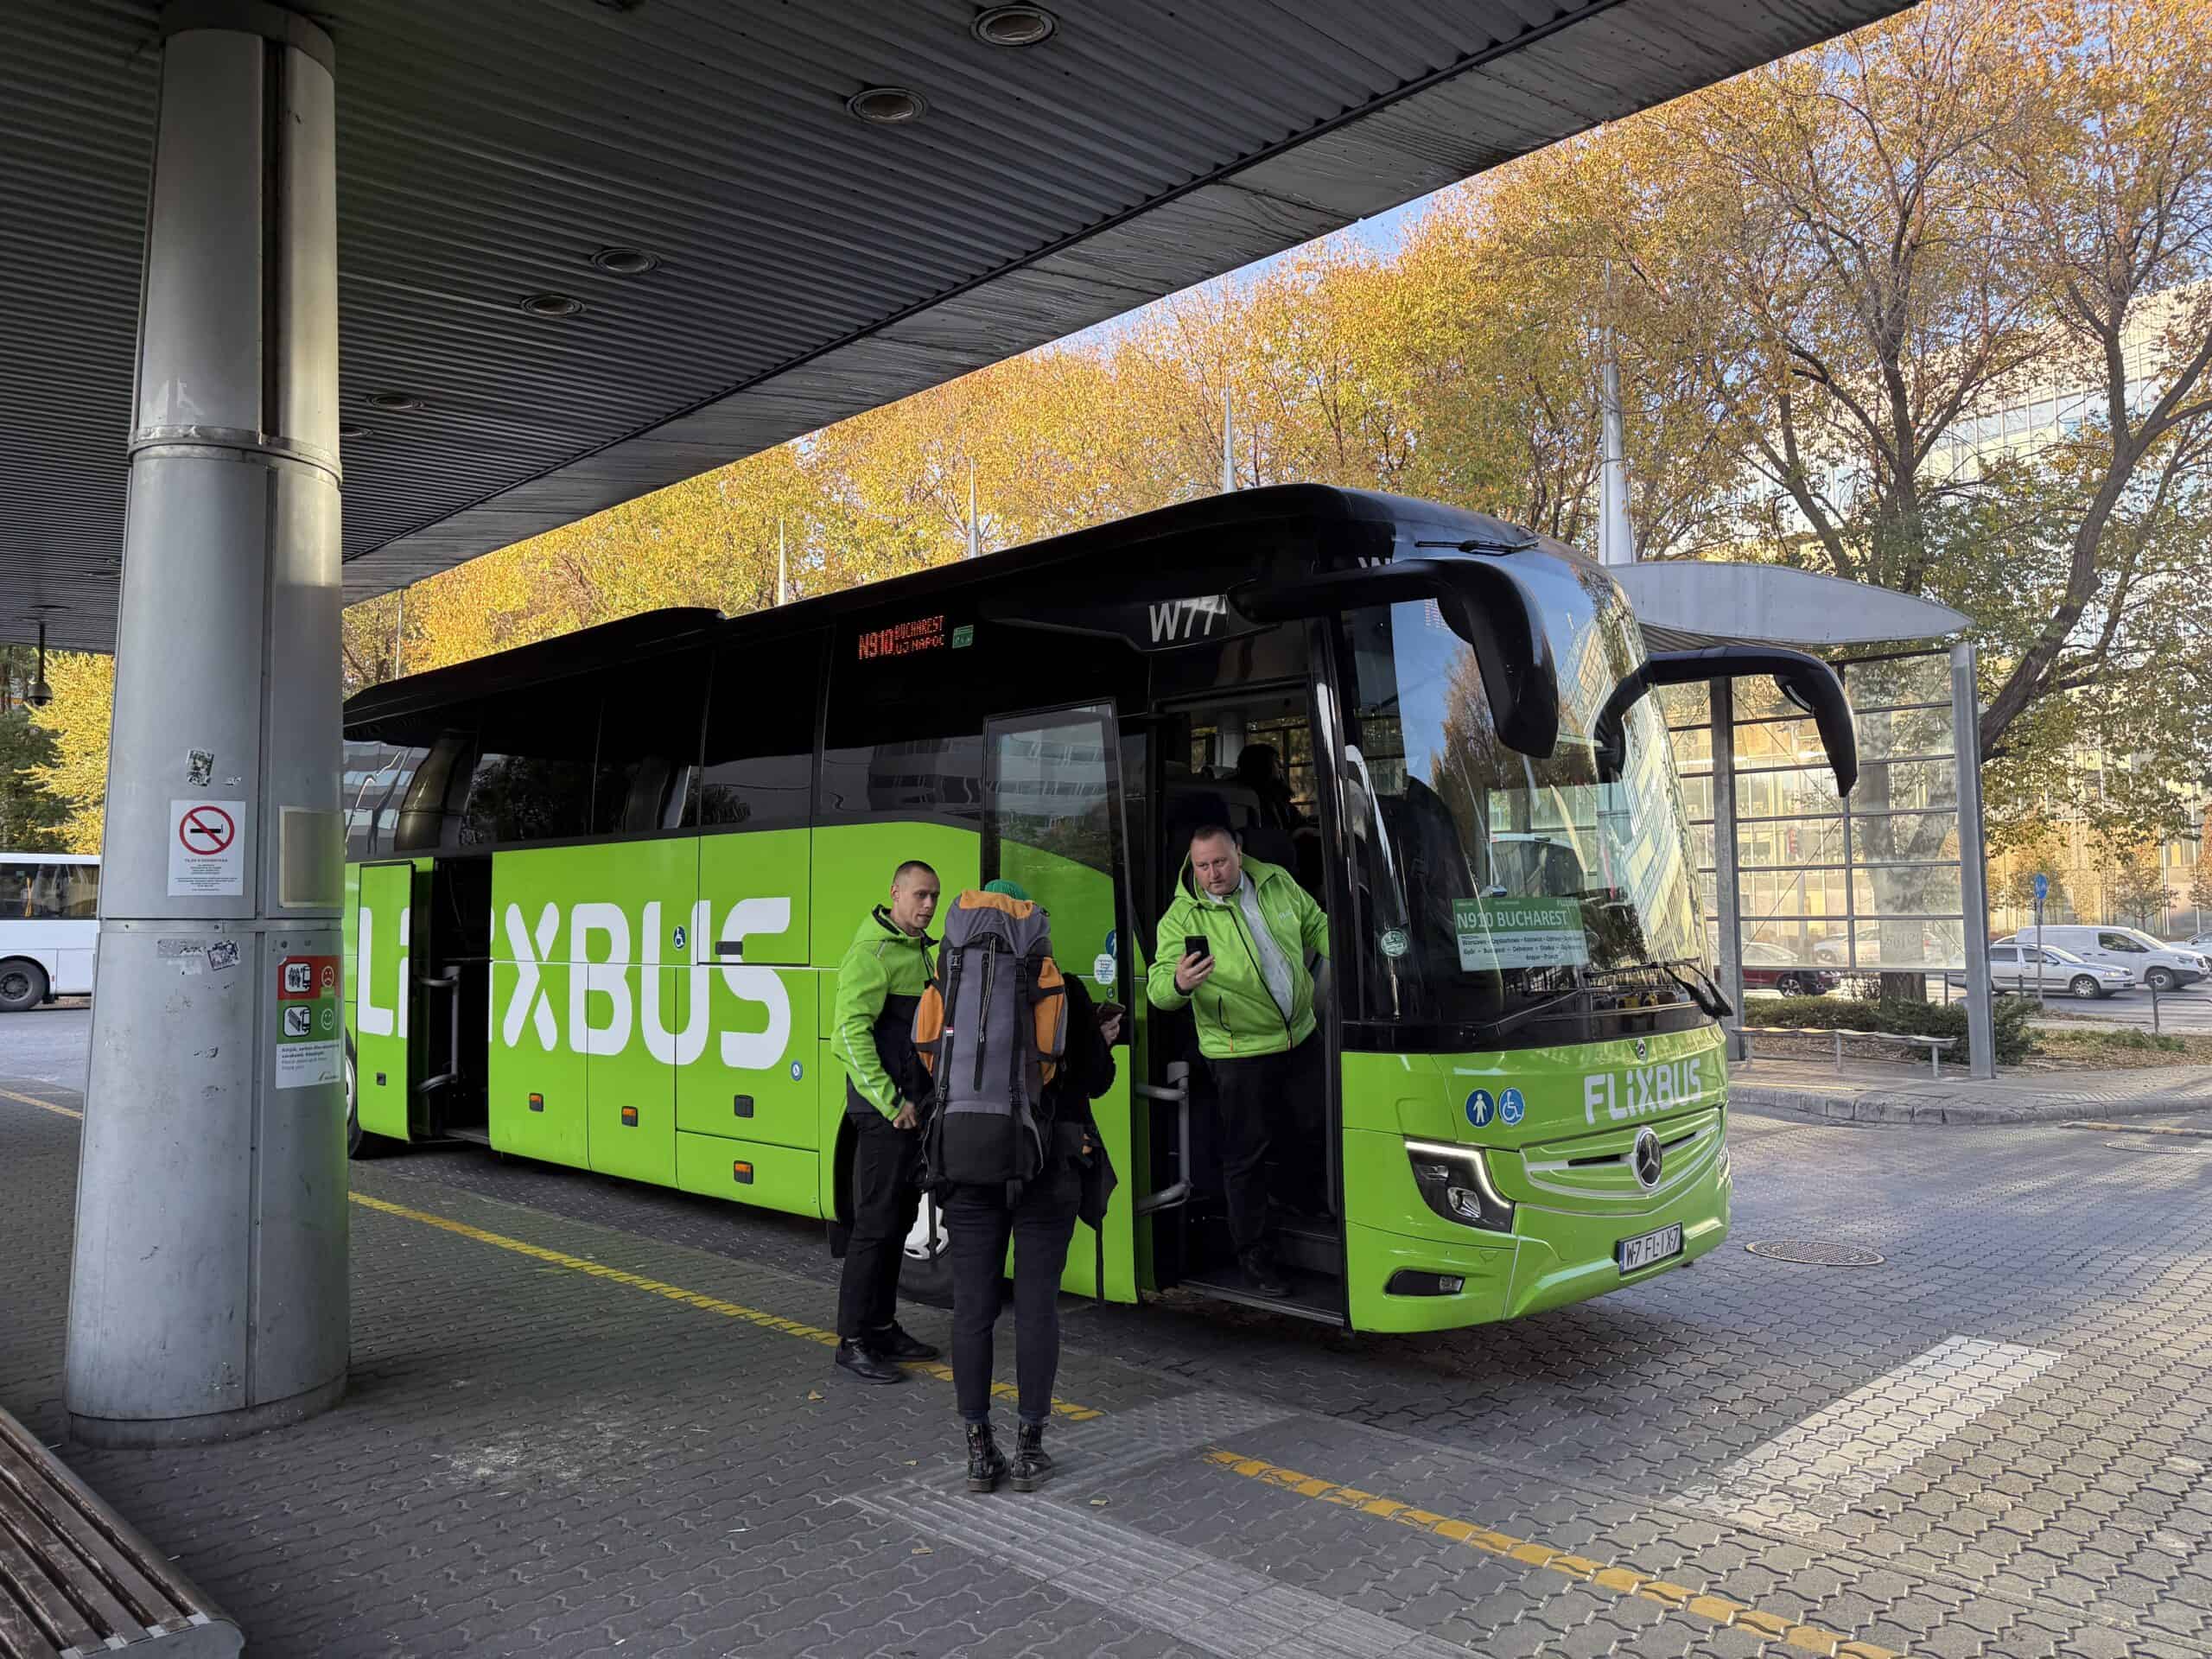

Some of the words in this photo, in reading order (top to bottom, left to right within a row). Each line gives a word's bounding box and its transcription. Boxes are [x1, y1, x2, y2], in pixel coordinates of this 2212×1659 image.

[858, 629, 893, 659] N910
[895, 614, 944, 640] BUCHAREST
[1457, 912, 1493, 929] N910
[1497, 910, 1568, 927] BUCHAREST
[357, 897, 791, 1070] LiXBUS
[1584, 1057, 1701, 1126] FLiXBUS
[1626, 1241, 1642, 1268] W7
[1645, 1227, 1679, 1261] FLIX7
